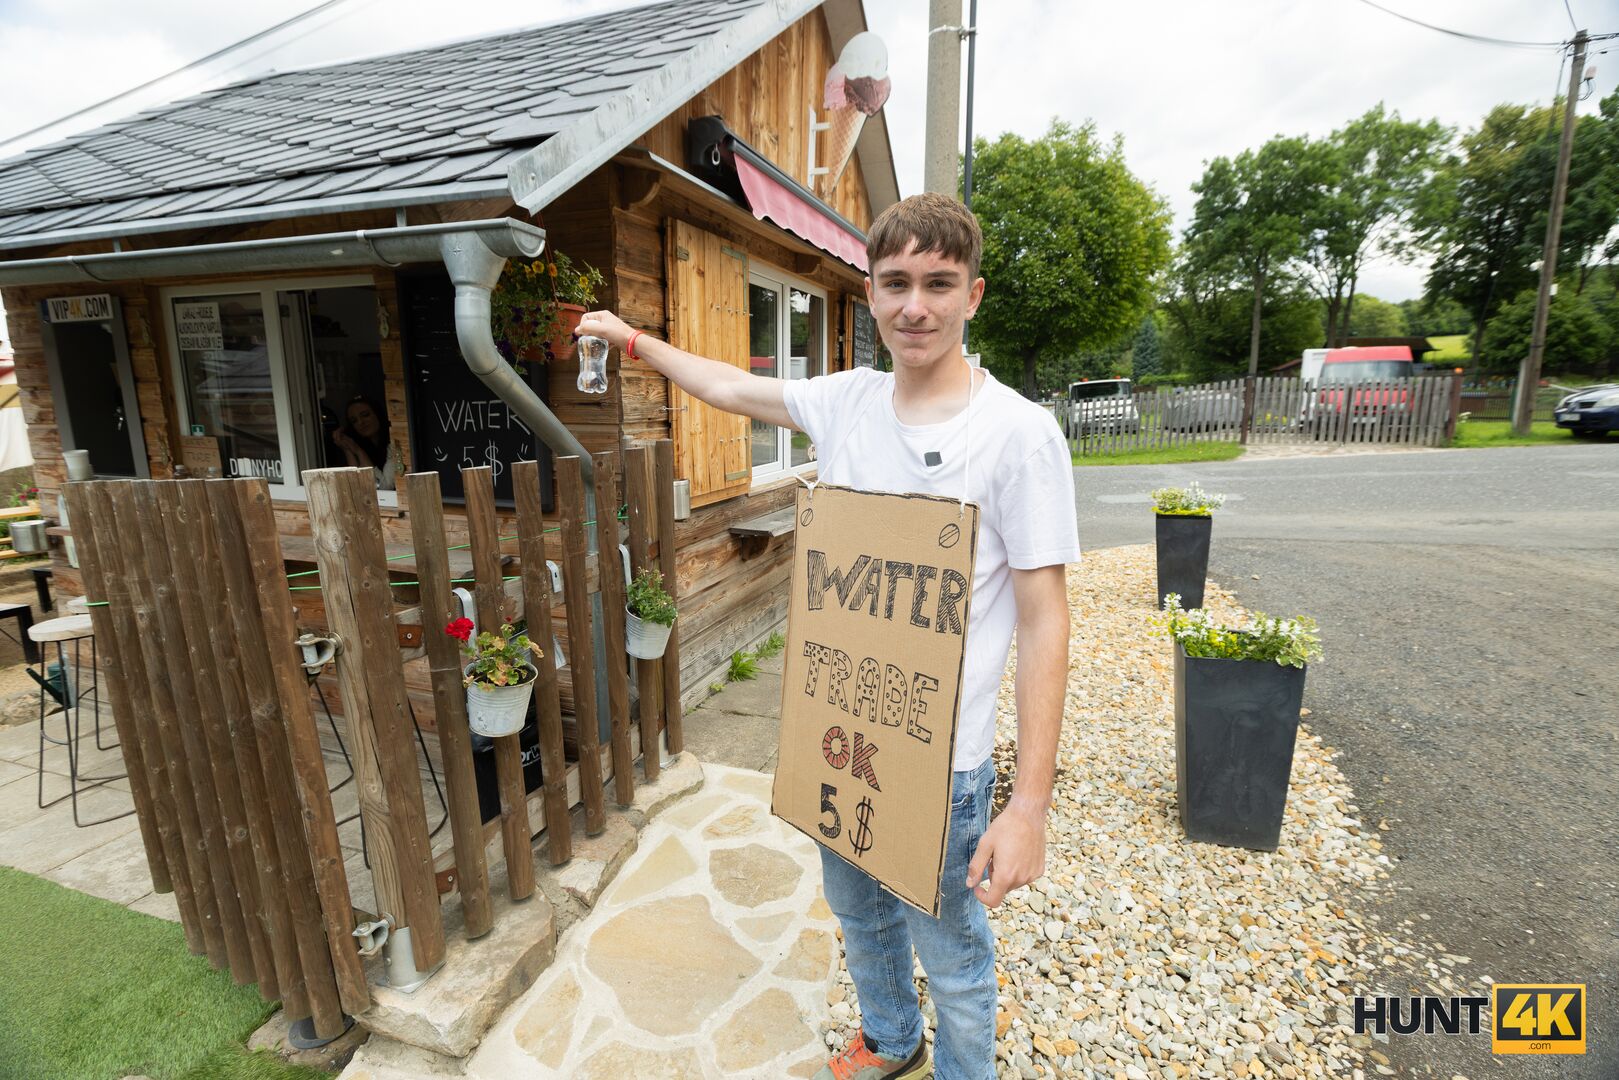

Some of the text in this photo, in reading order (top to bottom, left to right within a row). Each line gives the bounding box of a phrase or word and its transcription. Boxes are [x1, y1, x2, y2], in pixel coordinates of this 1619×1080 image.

[51, 296, 110, 320] VIP4K.COM
[433, 399, 531, 436] WATER
[229, 457, 283, 478] DNYHO
[807, 549, 968, 635] WATER
[803, 640, 940, 744] TRADE
[821, 725, 882, 793] OK
